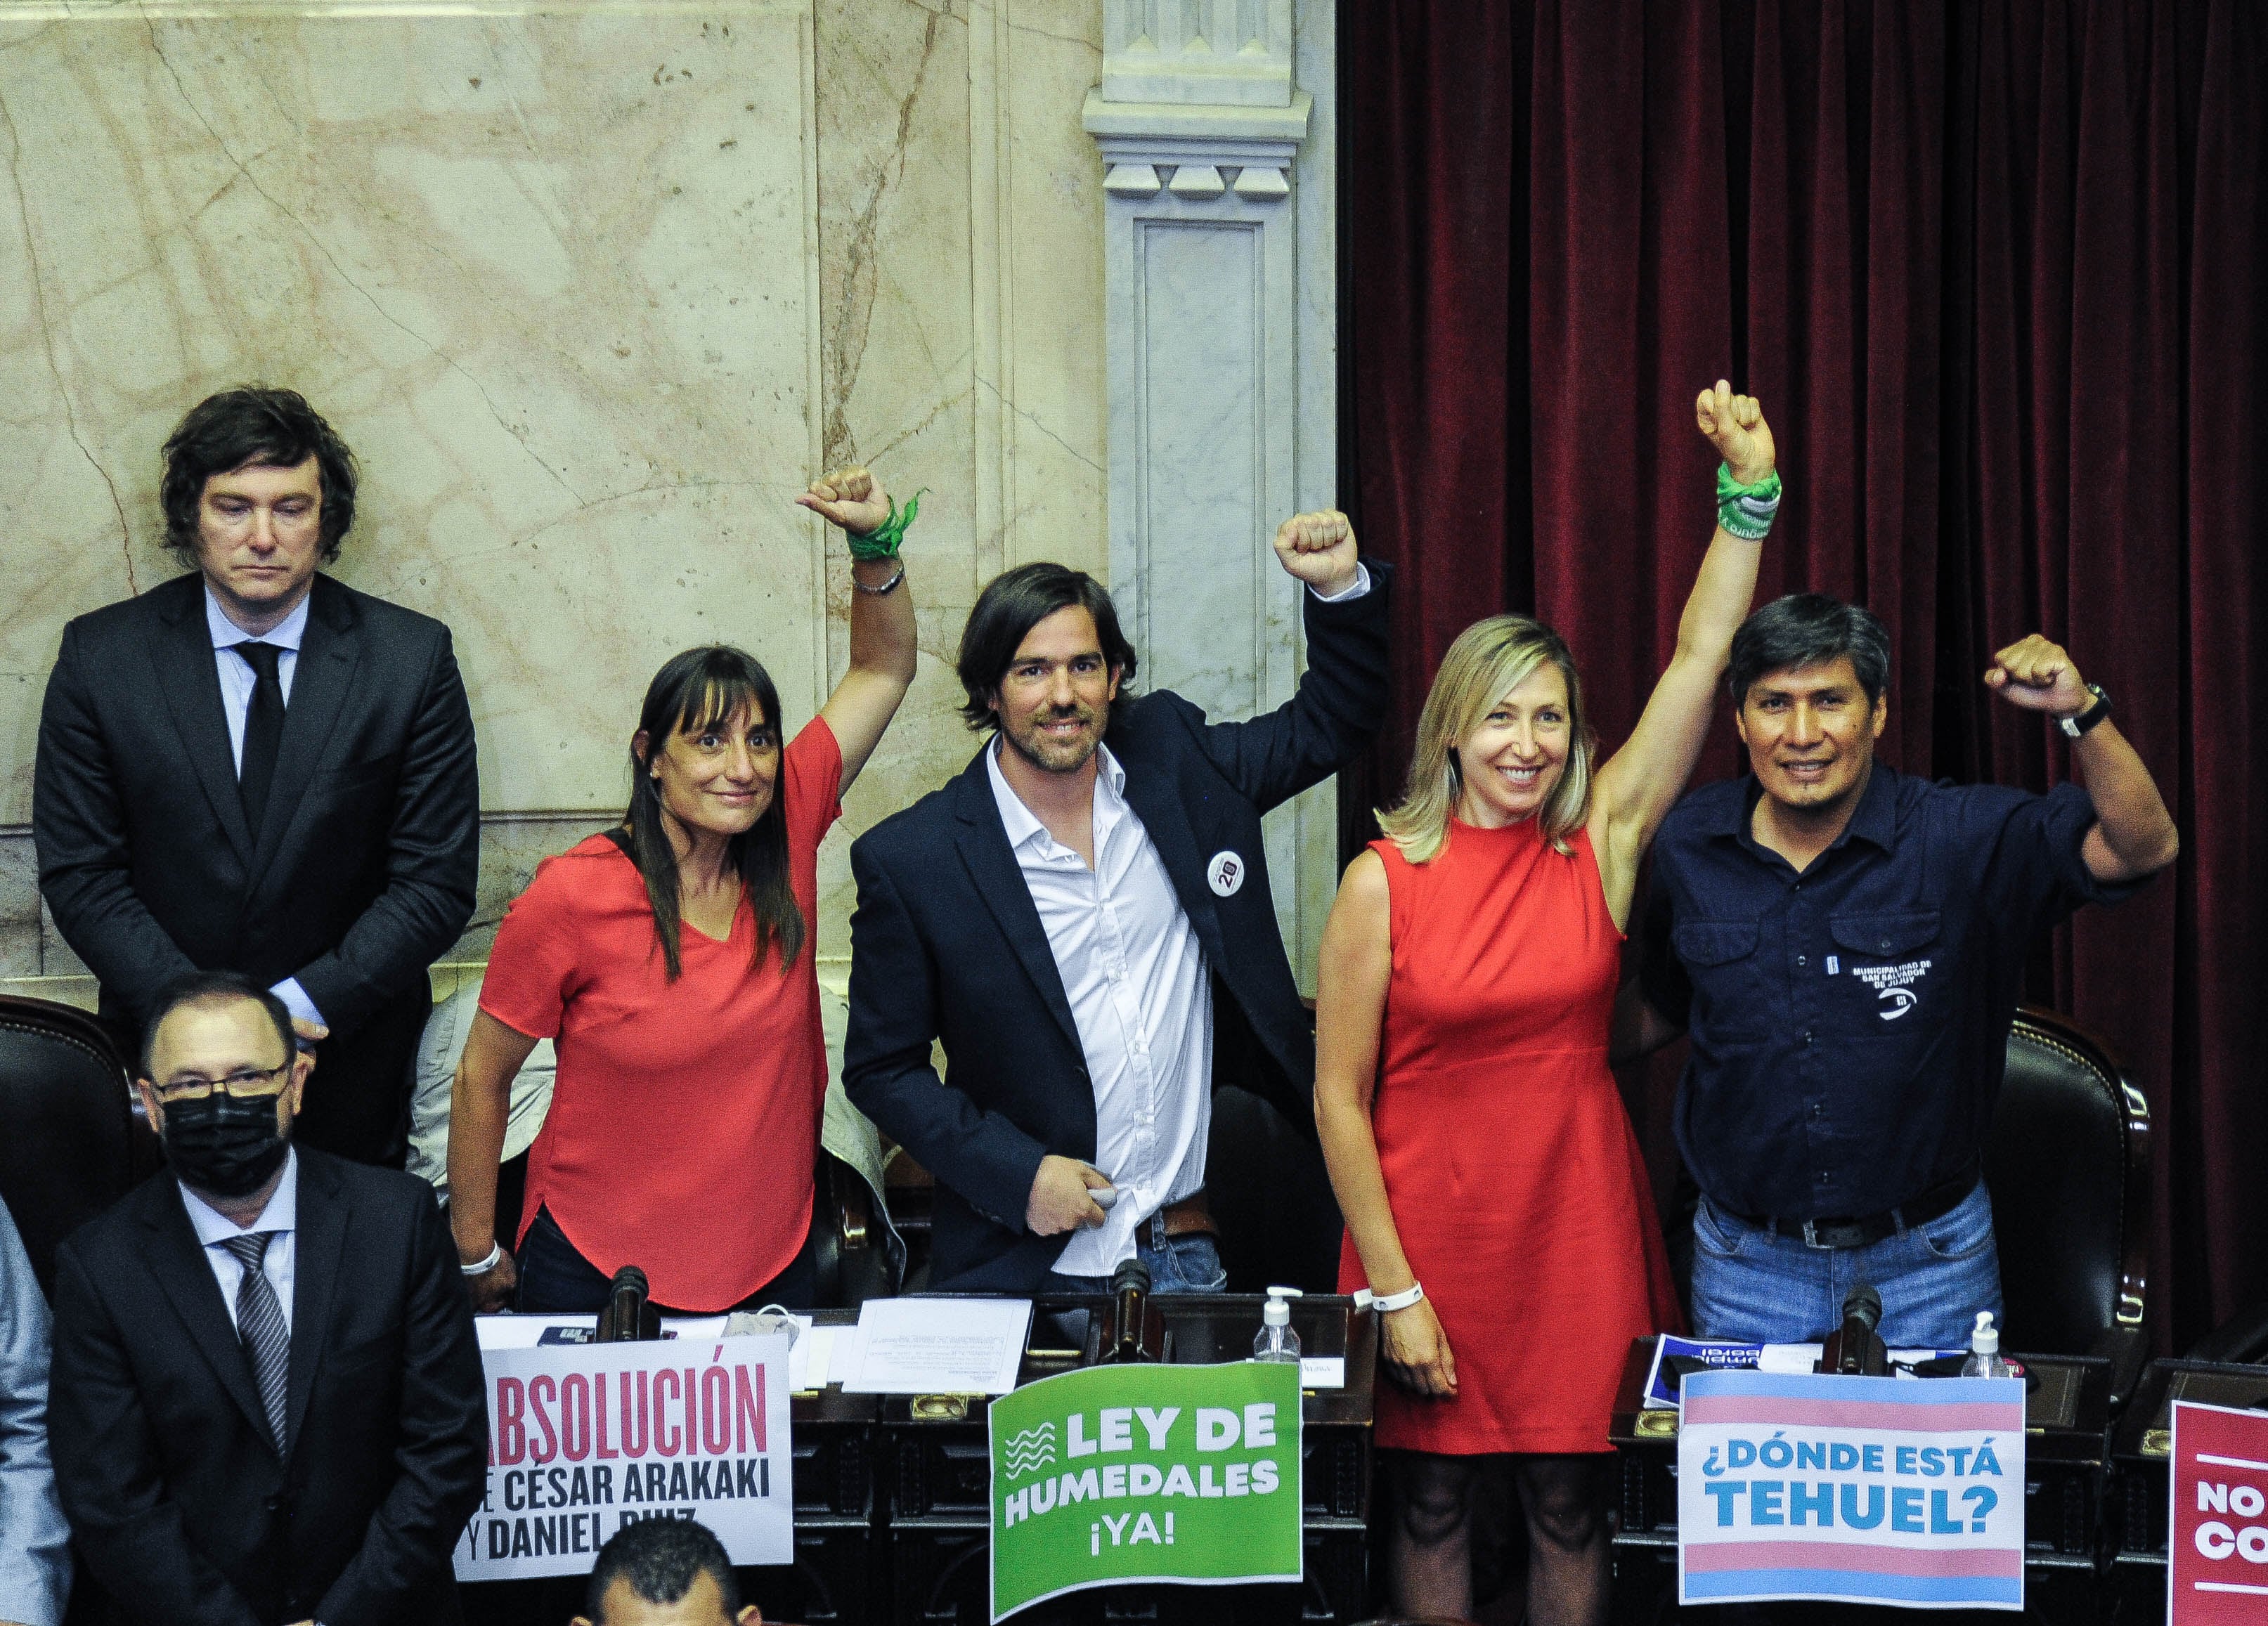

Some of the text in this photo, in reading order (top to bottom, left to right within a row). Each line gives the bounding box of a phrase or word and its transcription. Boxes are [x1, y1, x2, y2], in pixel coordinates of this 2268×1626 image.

[1853, 961, 1919, 976] MUNICIPALIDAD
[487, 1344, 767, 1466] BSOLUCIÓN
[1066, 1403, 1276, 1459] LEY DE
[1702, 1431, 2003, 1477] ¿DÓNDE ESTÁ
[505, 1459, 614, 1510] CÉSAR
[623, 1459, 770, 1504] ARAKAKI
[1005, 1459, 1280, 1528] HUMEDALES
[1704, 1479, 1999, 1534] TEHUEL?
[2197, 1481, 2265, 1517] NO
[488, 1511, 602, 1560] DANIEL
[1090, 1512, 1175, 1557] ¡YA!
